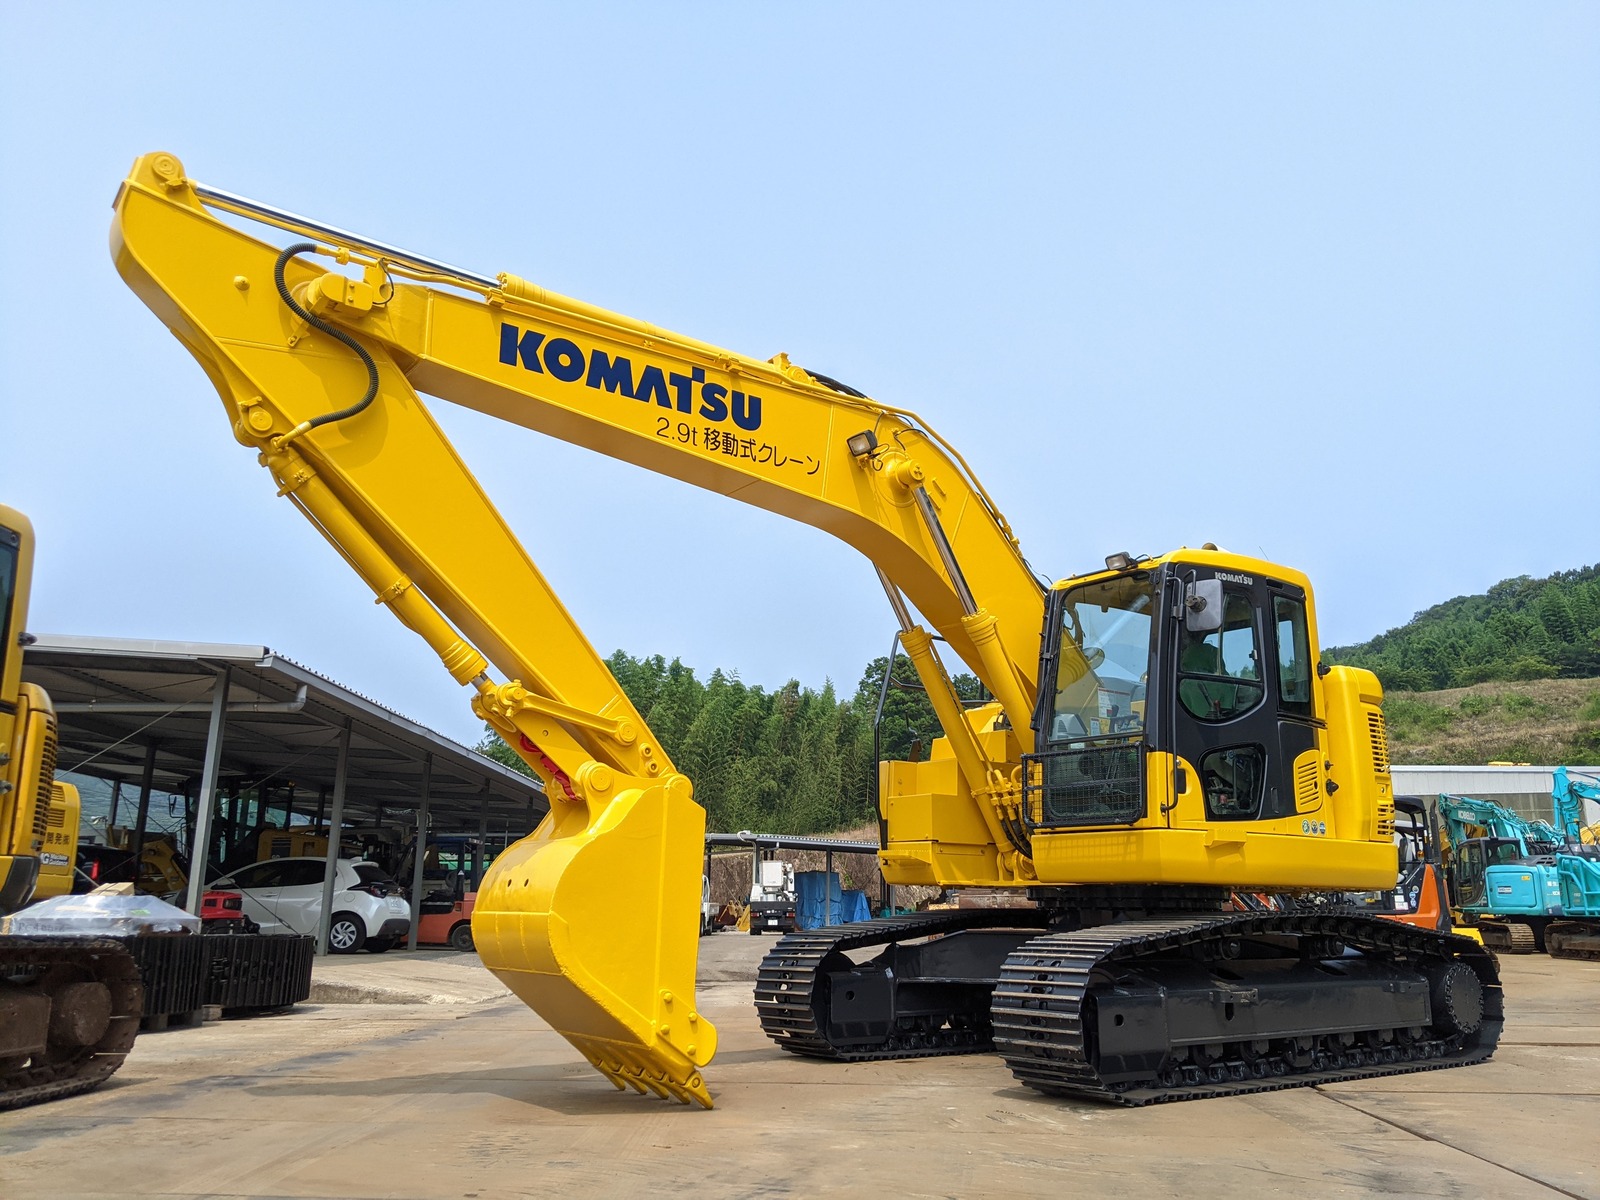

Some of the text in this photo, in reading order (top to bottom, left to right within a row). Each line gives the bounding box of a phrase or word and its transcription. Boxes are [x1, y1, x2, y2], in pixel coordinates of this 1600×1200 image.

[499, 322, 762, 431] KOMATSU
[656, 416, 821, 475] 2.9t 移動式クレーン
[1214, 571, 1253, 586] KOMATSU
